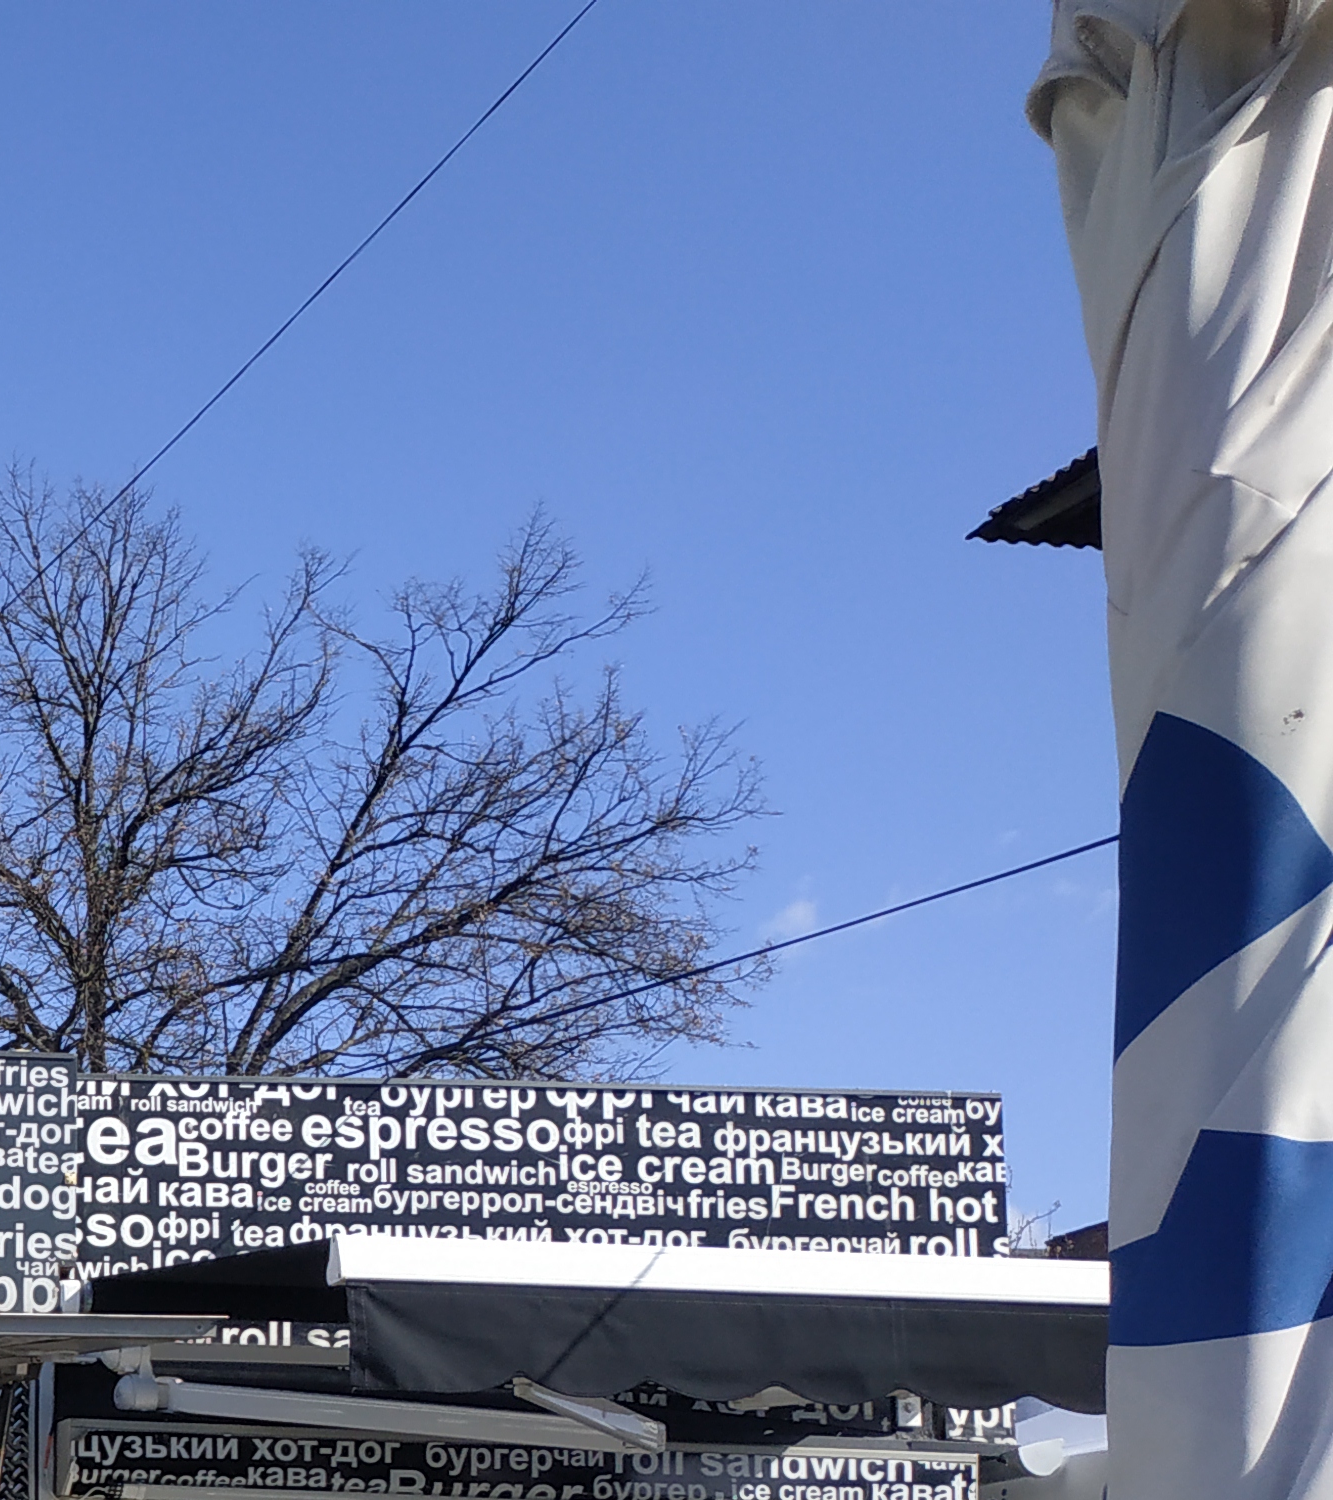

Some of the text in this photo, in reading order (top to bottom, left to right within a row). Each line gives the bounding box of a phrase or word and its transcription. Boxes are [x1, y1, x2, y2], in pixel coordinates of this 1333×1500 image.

[179, 1113, 971, 1160] coffee espresso tea французький
[179, 1143, 958, 1189] Burger roll sandwich cream Burger coffee
[159, 1181, 914, 1222] кава fries French
[247, 1466, 326, 1488] кава
[252, 1439, 554, 1476] хот-дог бургер
